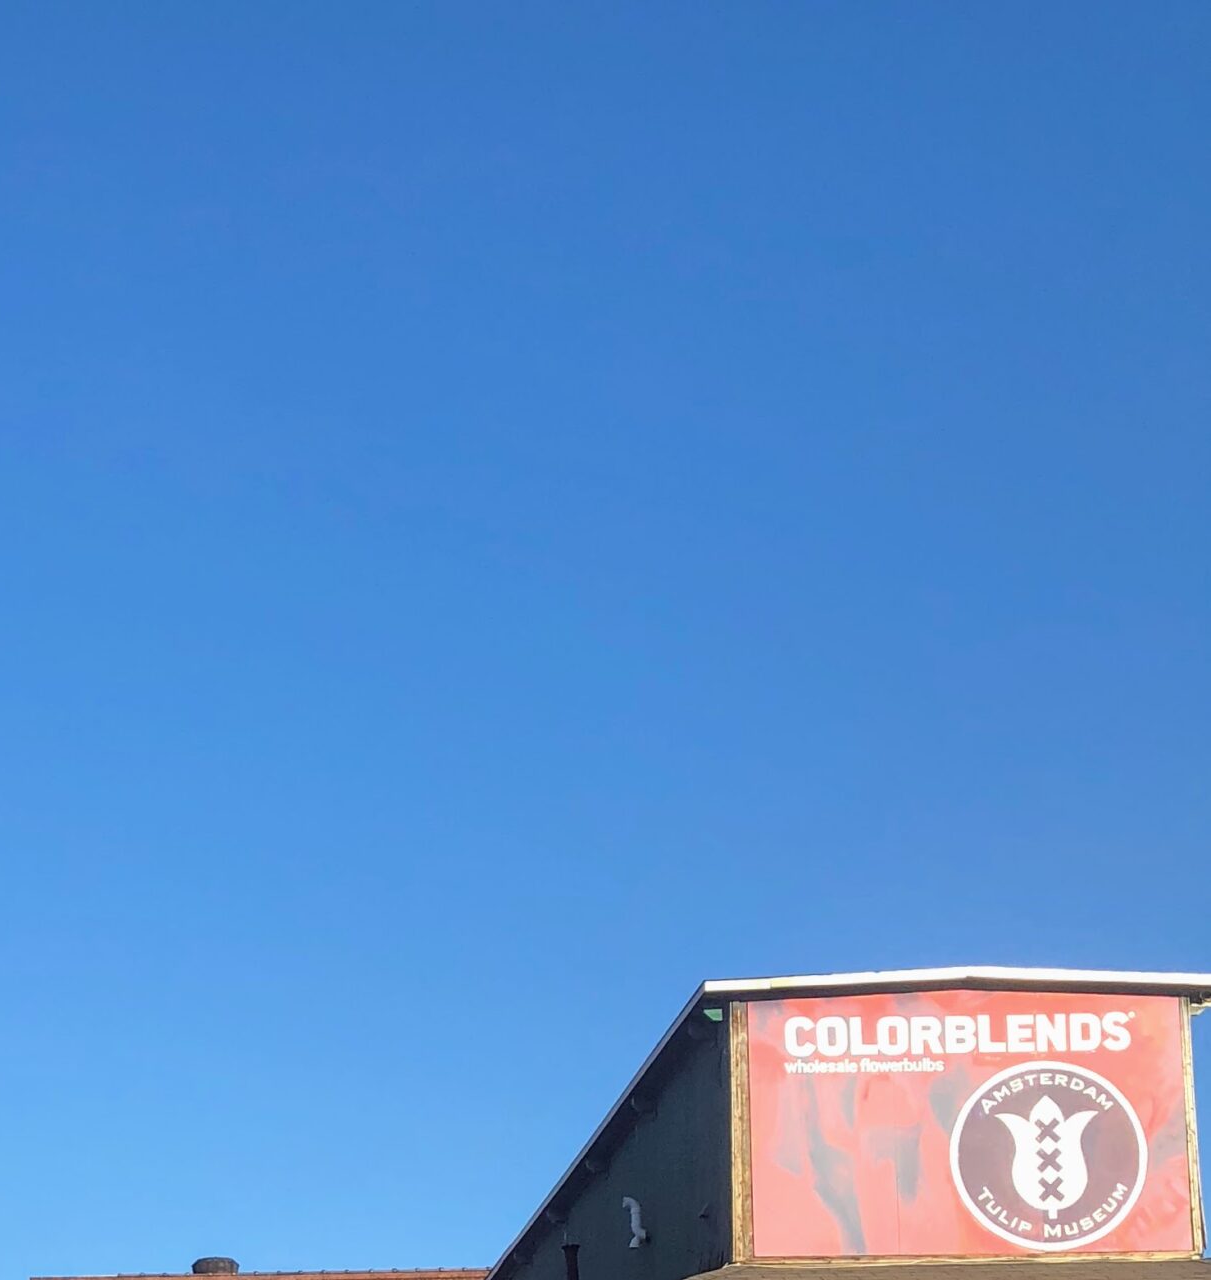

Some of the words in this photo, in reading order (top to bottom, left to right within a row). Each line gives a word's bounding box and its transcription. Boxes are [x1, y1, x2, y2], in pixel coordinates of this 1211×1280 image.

[784, 1011, 1132, 1057] COLORBLENDS
[784, 1059, 858, 1073] wholesale
[860, 1057, 945, 1073] flowerbulbs
[980, 1073, 1114, 1115] AMSTERDAM
[978, 1186, 1033, 1232] TULIP
[1043, 1182, 1129, 1238] MUSEUM
